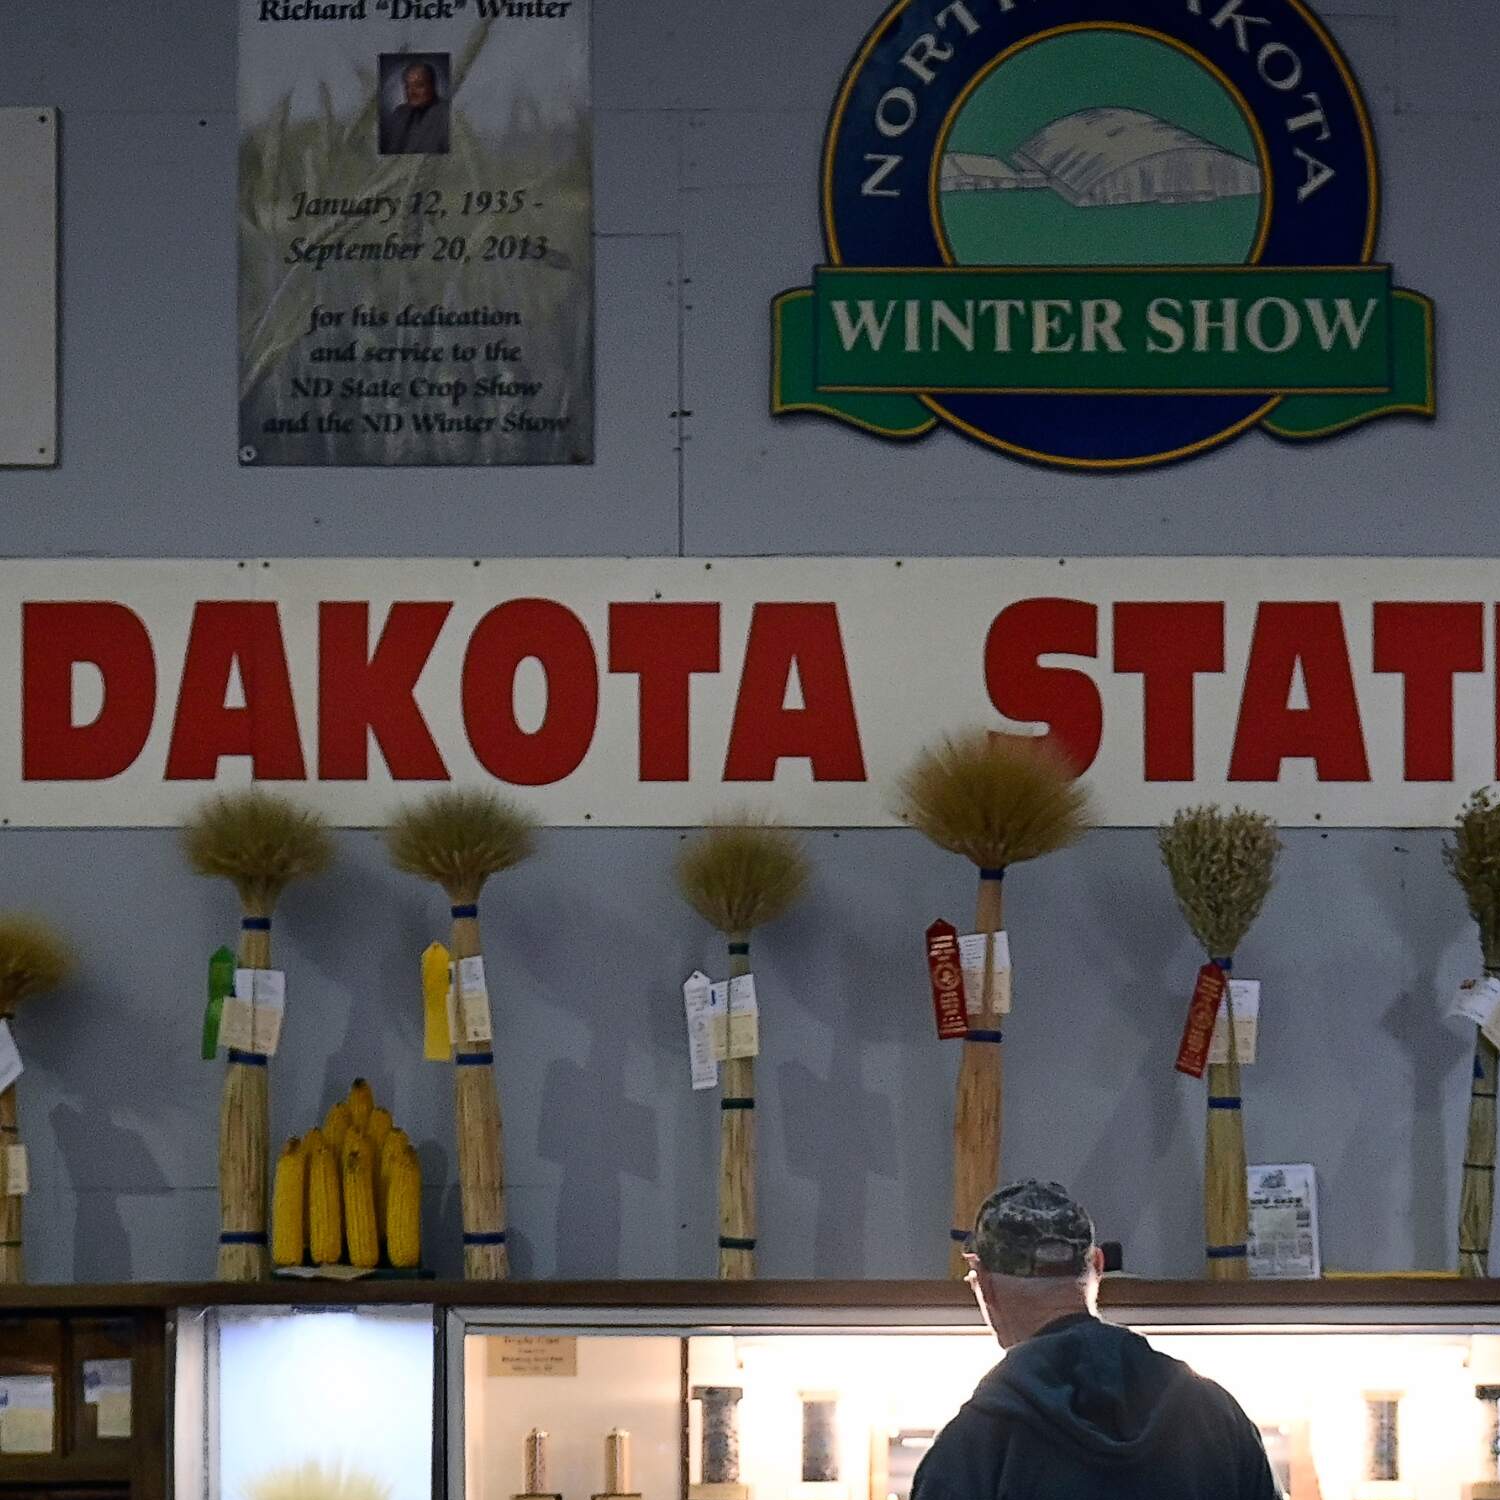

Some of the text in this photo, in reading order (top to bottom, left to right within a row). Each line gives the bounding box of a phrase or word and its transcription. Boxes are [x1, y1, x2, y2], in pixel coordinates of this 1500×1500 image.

[258, 0, 366, 21] Richard
[476, 0, 572, 19] Winter
[861, 0, 1337, 203] NORT KOTA
[288, 191, 399, 224] January
[410, 190, 447, 218] 12,
[461, 190, 526, 215] 1935
[284, 233, 549, 270] September 20, 2013
[304, 304, 522, 335] for his dedication
[831, 296, 1378, 354] WINTER SHOW
[310, 340, 522, 362] and service to the
[290, 375, 543, 405] ND State Crop Show
[262, 411, 570, 433] and the ND Winter Show
[21, 598, 868, 786] DAKOTA
